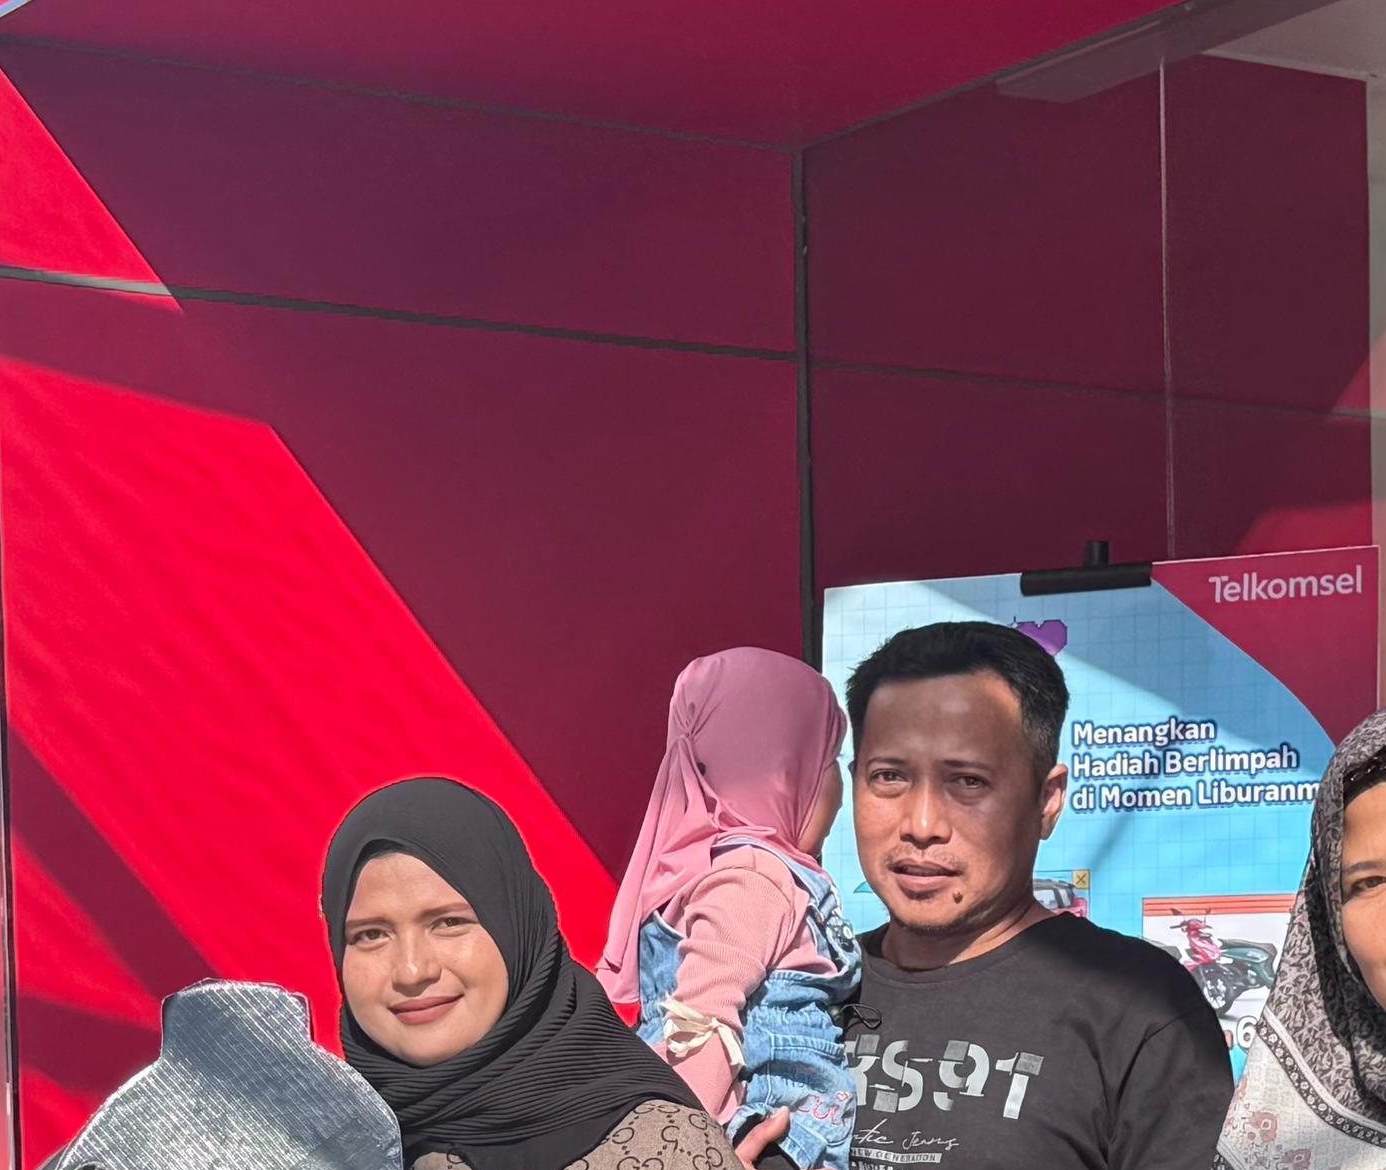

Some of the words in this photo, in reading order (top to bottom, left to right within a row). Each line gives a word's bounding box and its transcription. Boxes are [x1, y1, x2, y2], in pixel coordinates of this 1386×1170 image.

[1208, 564, 1363, 603] Telkomsel
[1072, 717, 1217, 747] Menangkan
[1072, 751, 1160, 779] Hadiah
[1163, 742, 1300, 776] Berlimpah
[1072, 784, 1096, 811] di
[1099, 784, 1193, 809] Momen
[1197, 779, 1321, 807] Liburanm
